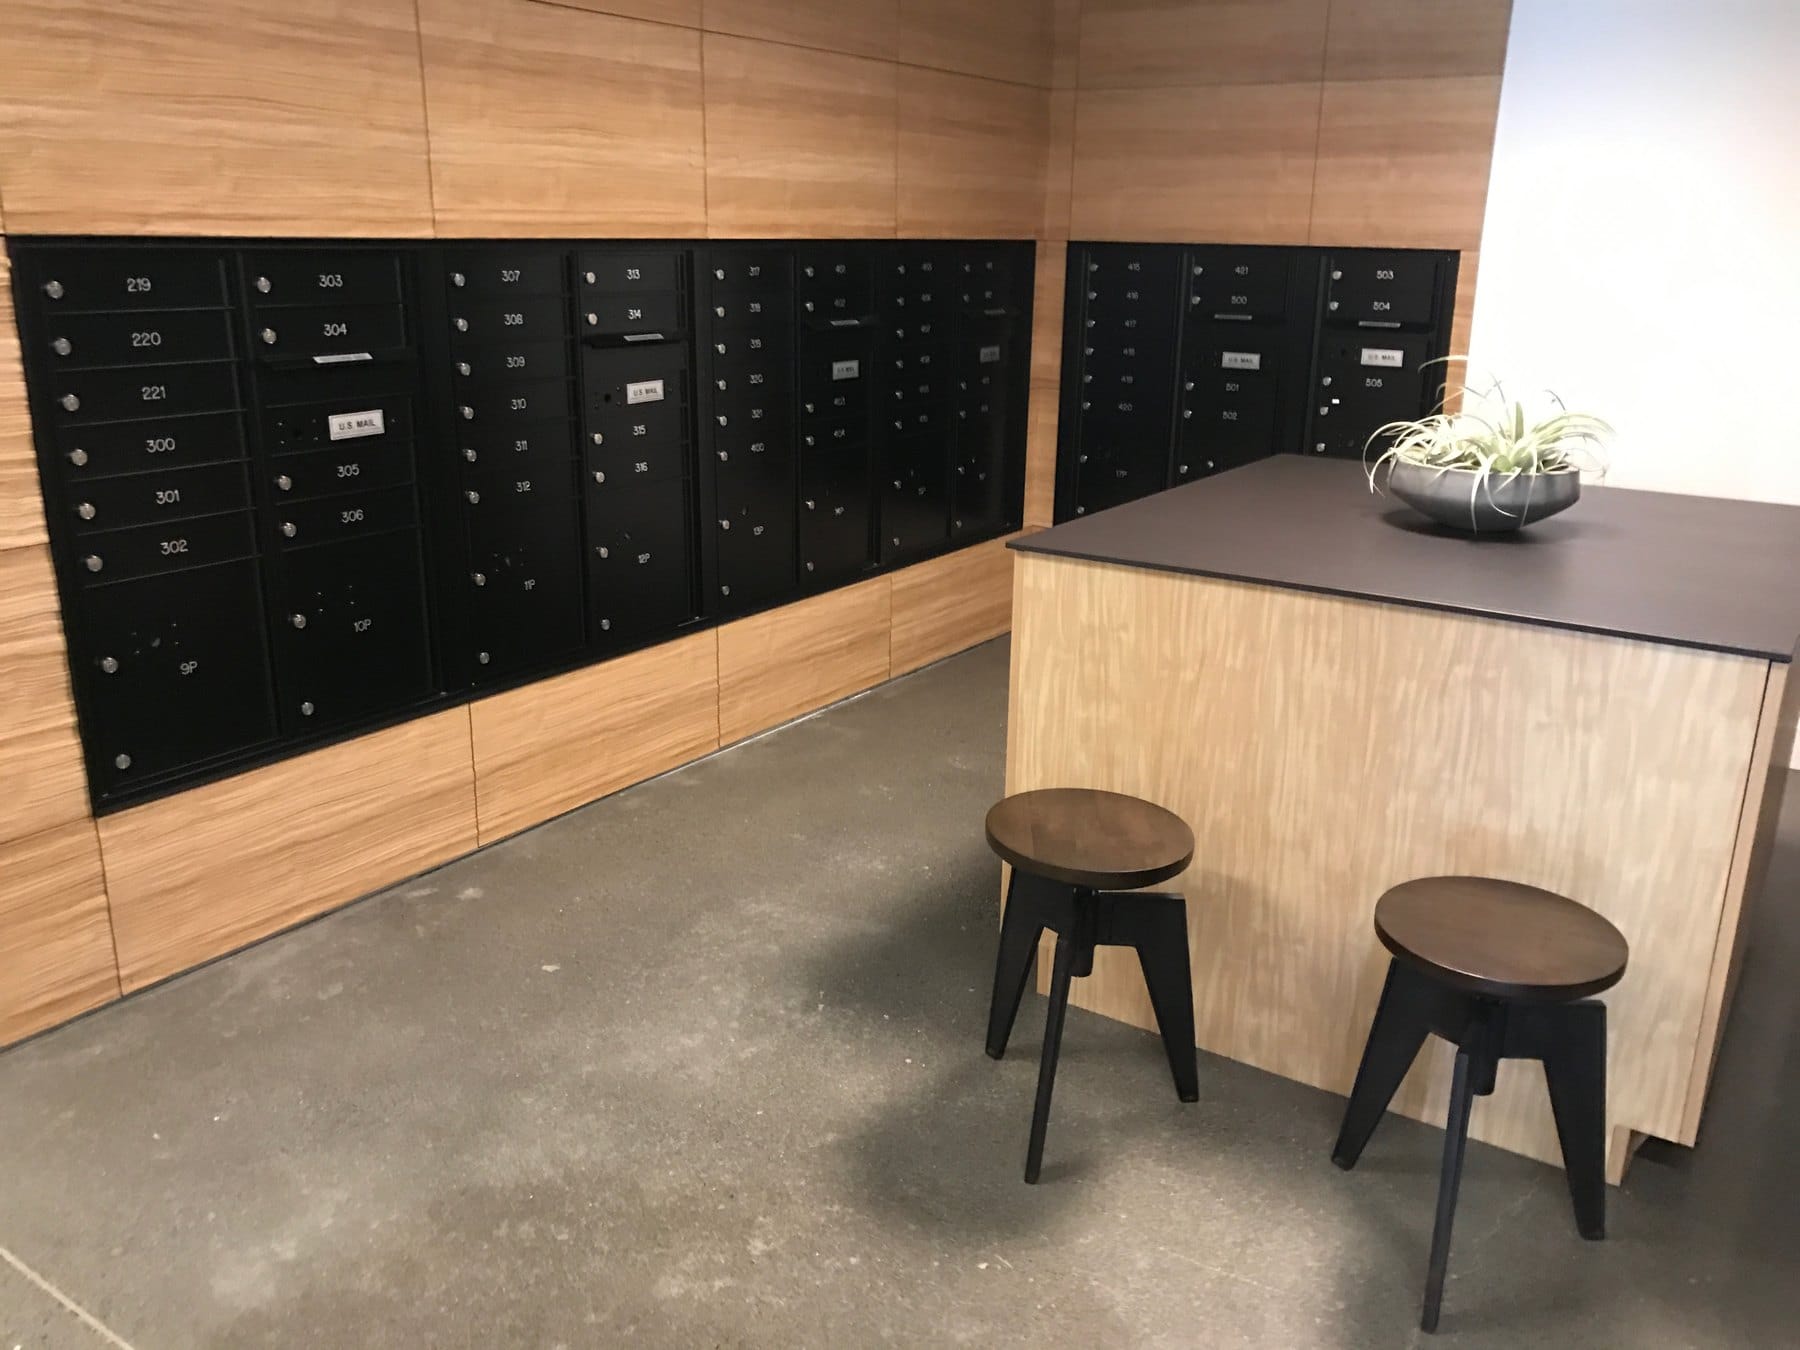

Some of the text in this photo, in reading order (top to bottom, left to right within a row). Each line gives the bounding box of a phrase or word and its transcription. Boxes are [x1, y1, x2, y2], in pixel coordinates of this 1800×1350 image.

[501, 269, 521, 282] 307
[626, 268, 641, 280] 313
[1376, 270, 1394, 280] 503
[126, 277, 152, 293] 219
[318, 274, 344, 288] 303
[1231, 295, 1248, 305] 500
[1372, 301, 1391, 311] 504
[503, 313, 524, 326] 308
[628, 309, 642, 320] 314
[323, 322, 348, 337] 304
[131, 331, 162, 347] 220
[506, 355, 526, 368] 309
[1225, 382, 1240, 392] 501
[1365, 377, 1383, 388] 505
[141, 385, 166, 401] 221
[511, 398, 527, 410] 310
[1222, 410, 1238, 421] 502
[356, 419, 377, 428] MAIL
[632, 424, 646, 436] 315
[146, 437, 176, 454] 300
[336, 463, 360, 478] 305
[634, 461, 649, 473] 316
[516, 480, 532, 493] 312
[155, 489, 180, 505] 301
[341, 508, 364, 524] 306
[159, 539, 189, 556] 302
[353, 618, 372, 633] 10P
[179, 660, 198, 676] 9P
